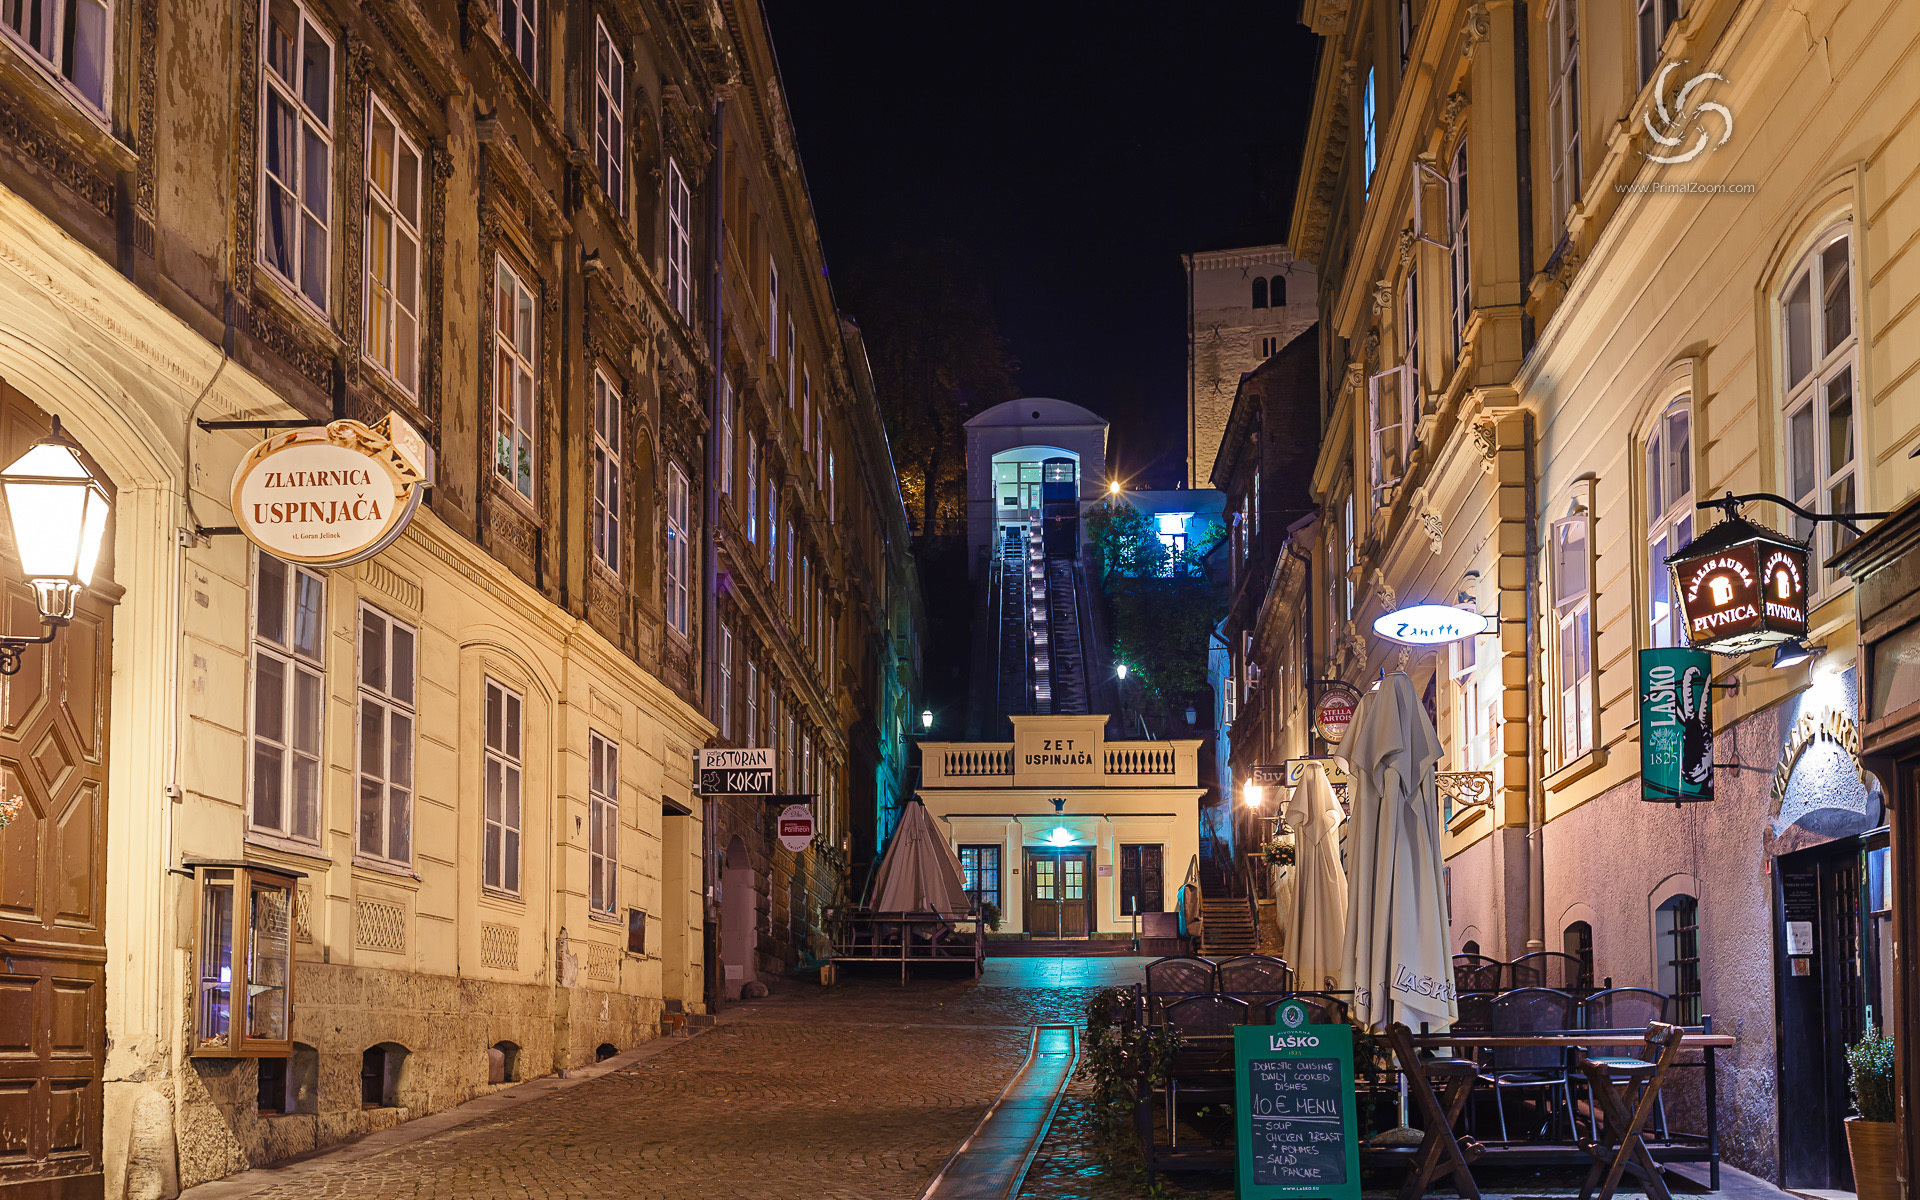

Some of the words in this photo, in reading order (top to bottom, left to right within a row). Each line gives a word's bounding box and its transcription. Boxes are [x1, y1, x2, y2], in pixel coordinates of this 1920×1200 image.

[264, 469, 371, 488] ZLATARNICA
[253, 493, 382, 524] USPINJAČA
[1688, 559, 1717, 603] VALLIS
[1718, 558, 1753, 588] AUREA
[1693, 604, 1758, 631] PIVNICA
[1766, 602, 1802, 622] PIVNICA
[1643, 666, 1676, 727] LAŠKO
[1323, 714, 1352, 722] ARTOIS
[1044, 740, 1074, 750] ZET
[706, 751, 767, 767] RESTORAN
[1025, 751, 1092, 765] USPINJAČA
[1650, 752, 1678, 765] 1825
[727, 771, 772, 792] KOKOT
[1392, 963, 1449, 1003] LAŠK
[1270, 1035, 1320, 1051] LAŠKO
[1253, 1062, 1292, 1071] DOMESTIC
[1296, 1062, 1334, 1071] CUISINE
[1260, 1072, 1286, 1082] DAILY
[1294, 1073, 1331, 1082] COOKED
[1274, 1082, 1308, 1091] DISHES
[1296, 1097, 1337, 1115] MENU
[1265, 1121, 1292, 1131] SOUP
[1265, 1132, 1304, 1142] CHICKEN
[1308, 1131, 1343, 1143] BREAST
[1281, 1144, 1319, 1155] POMMES
[1267, 1153, 1297, 1165] SALAD
[1280, 1166, 1321, 1178] PANCAKE
